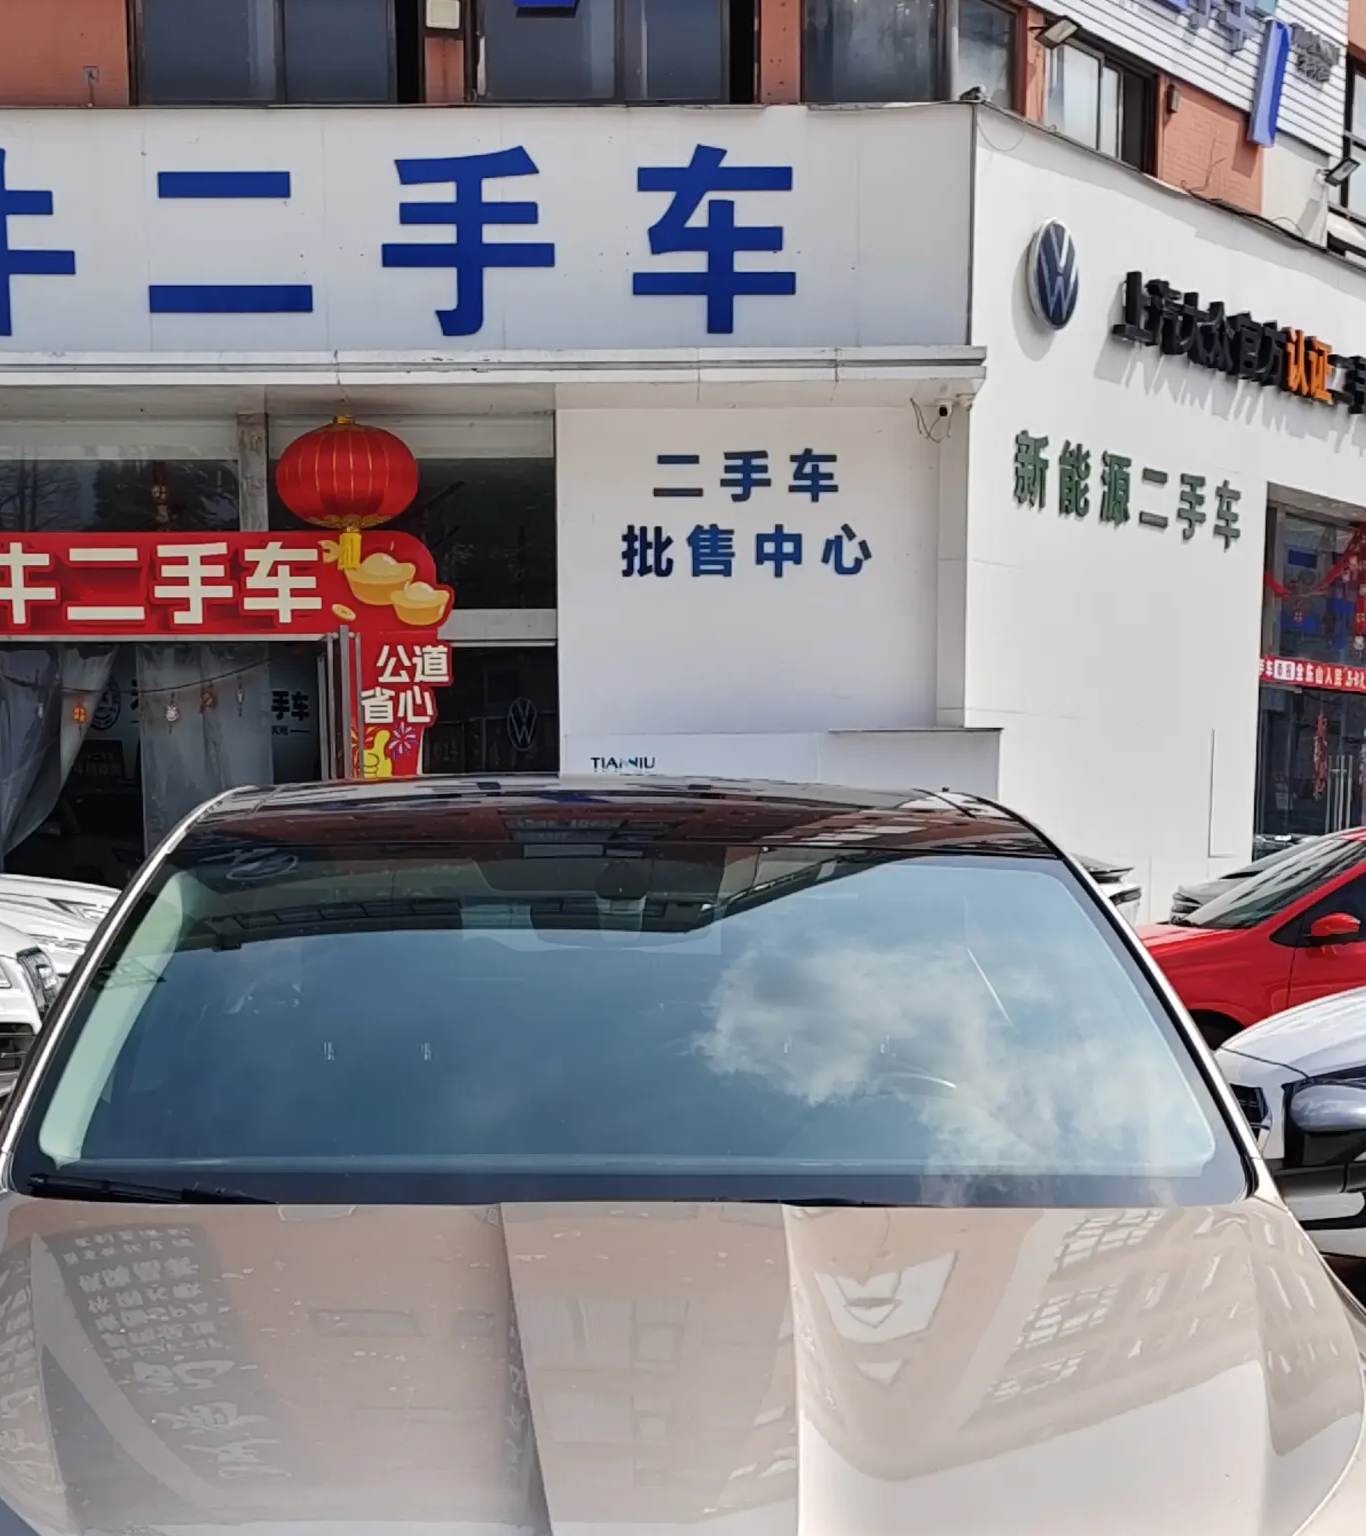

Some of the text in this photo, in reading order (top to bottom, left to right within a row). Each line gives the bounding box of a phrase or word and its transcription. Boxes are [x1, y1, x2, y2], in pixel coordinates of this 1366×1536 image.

[652, 447, 840, 504] 二手车
[1013, 429, 1242, 550] 新能源二手车
[620, 523, 872, 578] 批售中心
[375, 644, 450, 683] 公道
[360, 685, 434, 724] 省心
